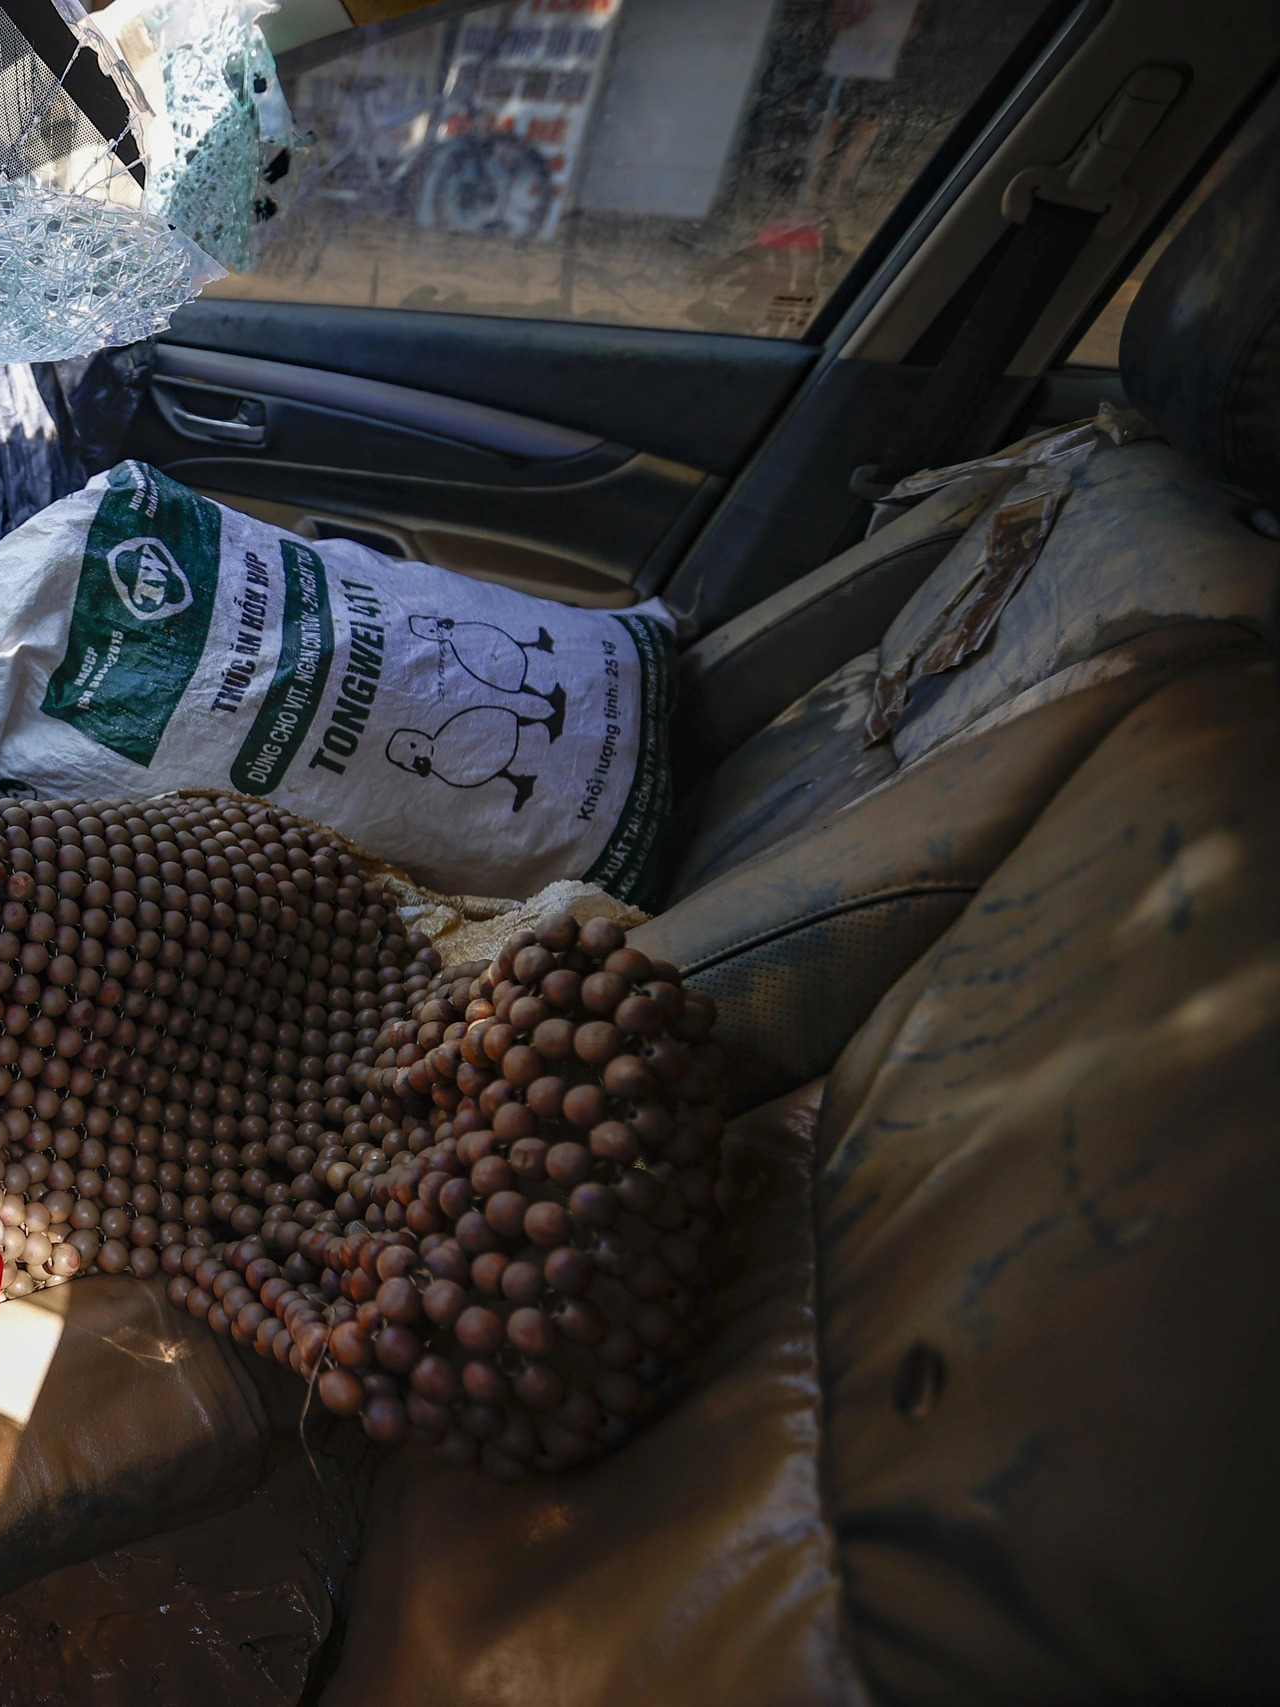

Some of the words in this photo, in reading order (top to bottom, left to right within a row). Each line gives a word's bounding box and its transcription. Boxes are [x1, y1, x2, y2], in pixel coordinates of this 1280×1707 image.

[133, 544, 169, 605] TW
[293, 564, 317, 597] NGÀY
[234, 587, 268, 631] HỖN
[301, 590, 319, 608] 21
[341, 579, 381, 618] 411
[229, 630, 262, 656] ĂN
[300, 632, 321, 649] CON
[602, 640, 616, 655] kg
[74, 646, 98, 687] HACCP
[77, 690, 94, 710] ISO
[88, 630, 124, 689] 9001:2015
[294, 648, 320, 684] NGAN
[605, 659, 619, 678] 25
[211, 659, 256, 713] THỨC
[283, 685, 313, 710] VỊT,
[309, 620, 385, 775] TONGWEI
[604, 682, 621, 719] tịnh:
[270, 711, 298, 743] CHO
[246, 743, 282, 784] DÙNG
[595, 724, 620, 774] lượng
[601, 840, 632, 879] XUẤT
[635, 773, 654, 812] CÔNG
[647, 660, 658, 716] TONGWEI
[577, 778, 604, 821] Khối
